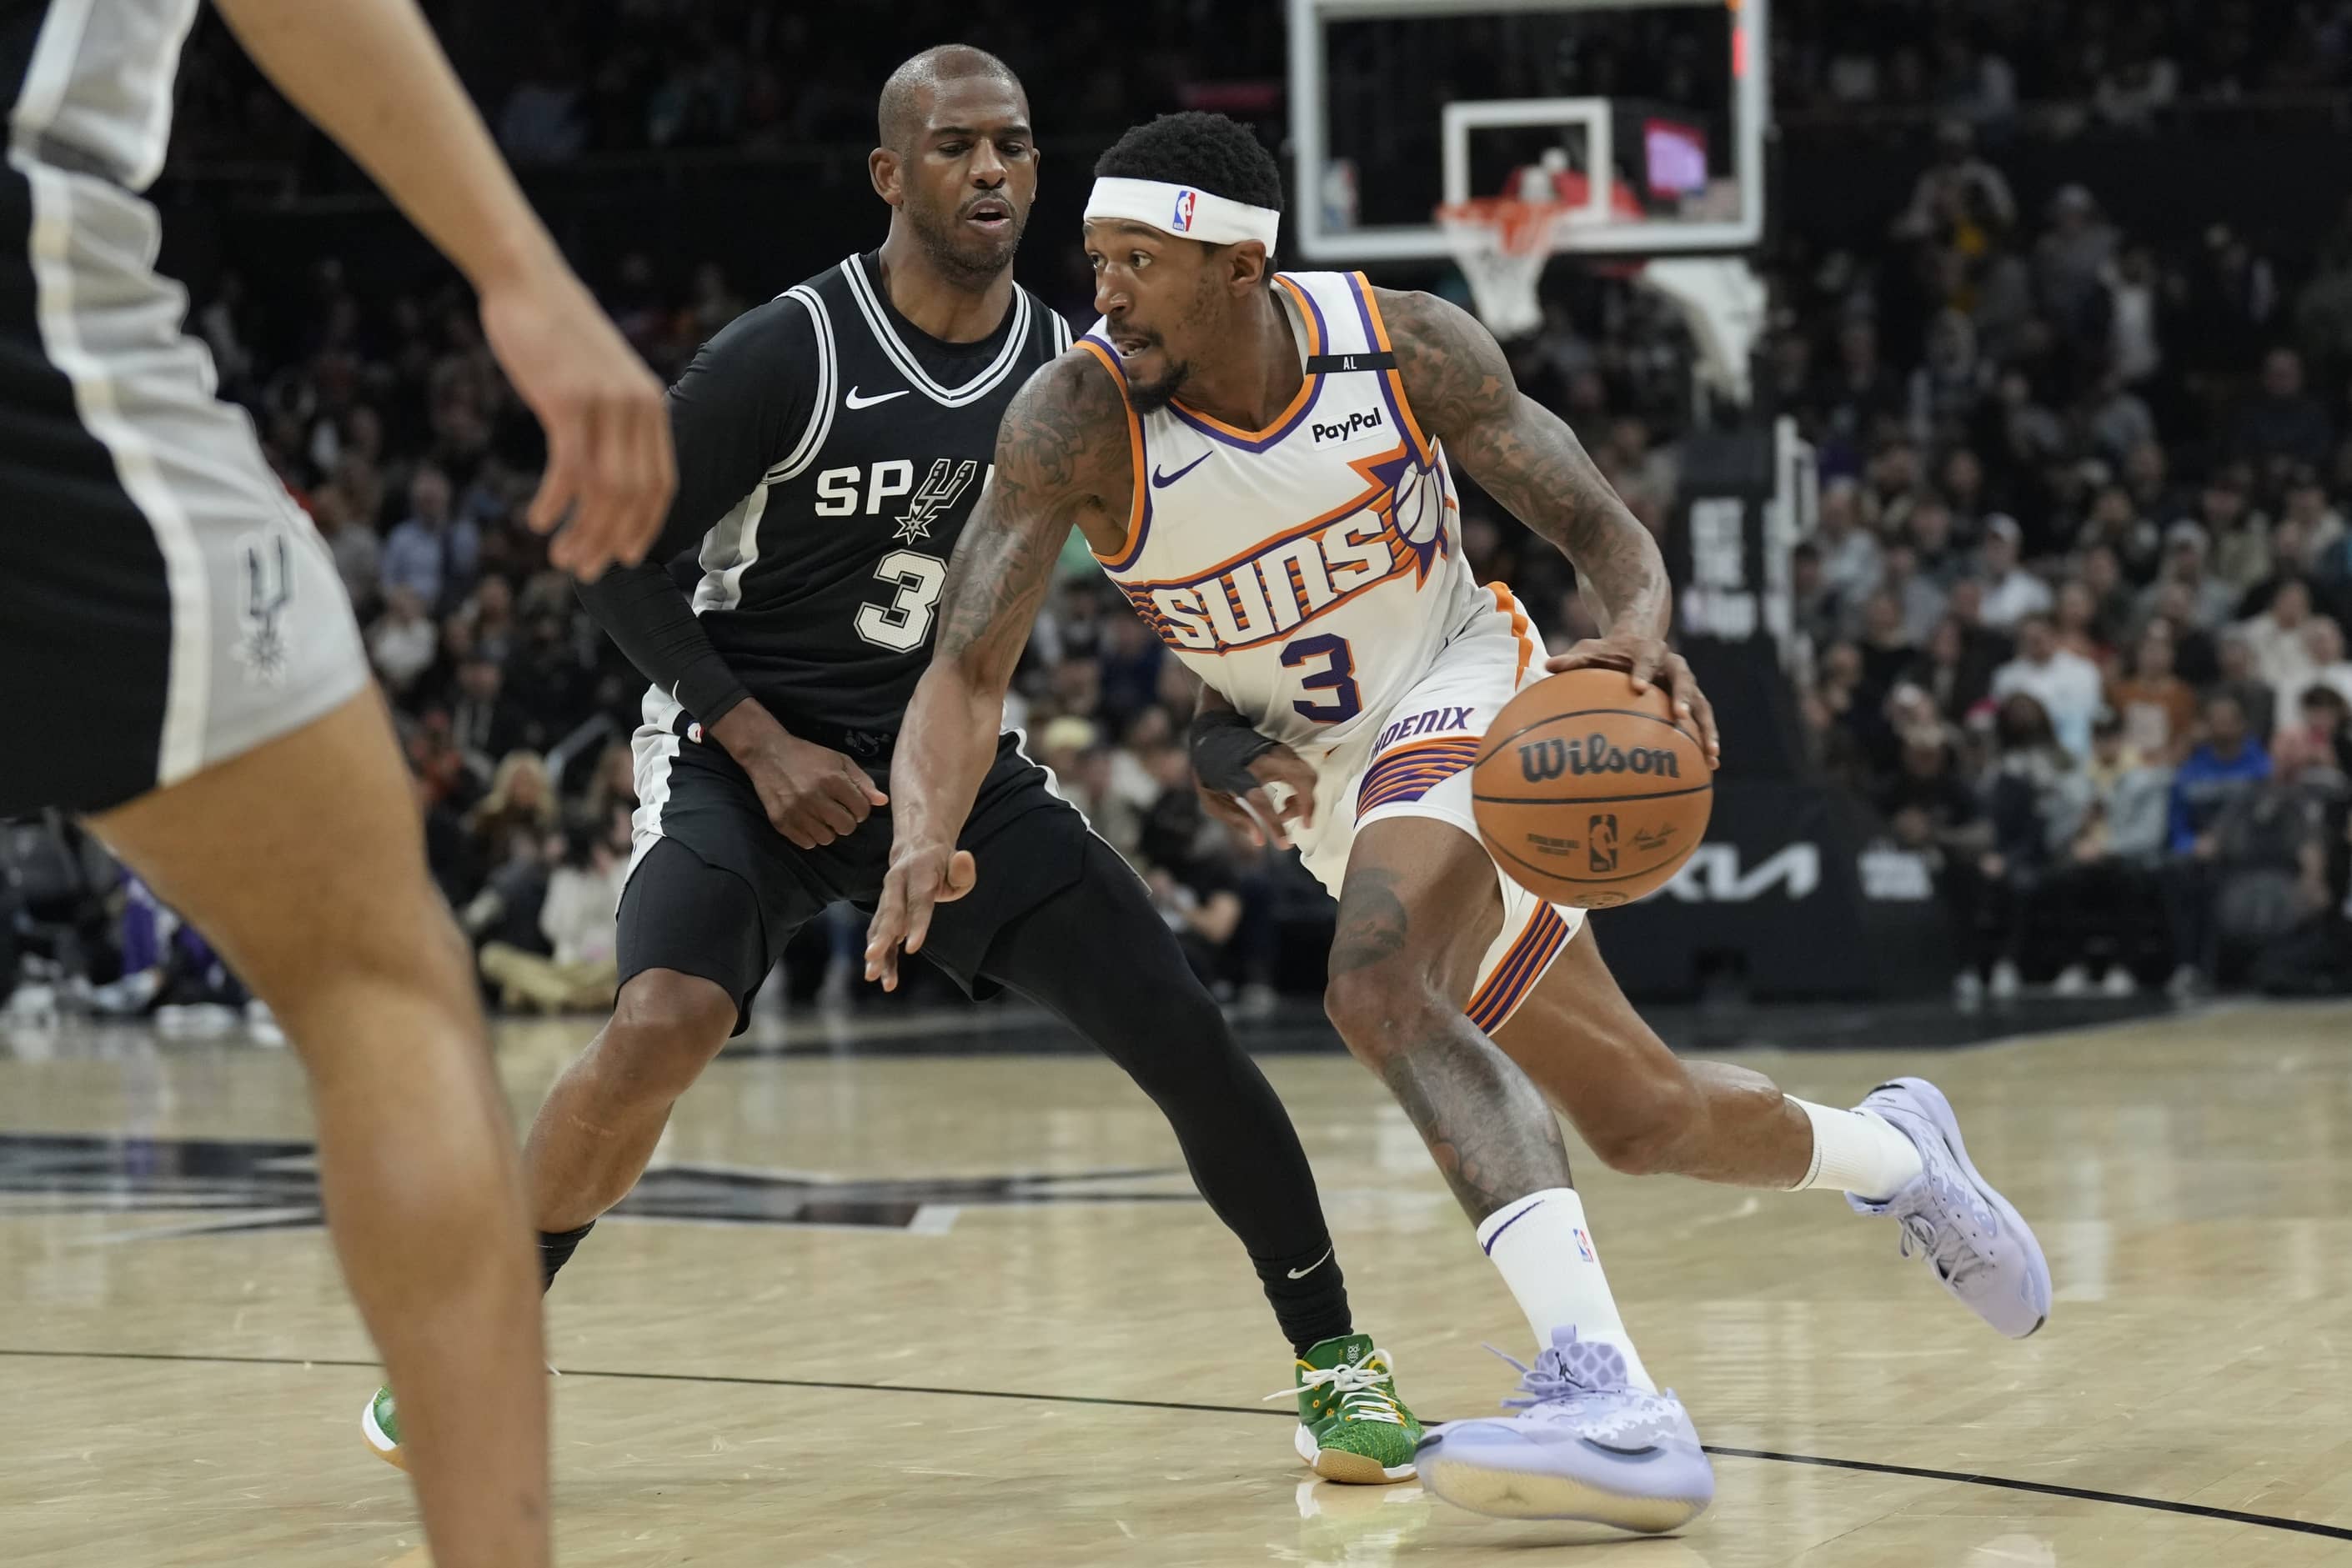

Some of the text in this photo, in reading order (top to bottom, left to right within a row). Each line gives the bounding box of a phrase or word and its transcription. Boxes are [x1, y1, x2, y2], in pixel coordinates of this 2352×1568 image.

[1343, 356, 1357, 370] AL
[1311, 407, 1382, 443] PayPal
[815, 458, 995, 544] SPU
[853, 549, 948, 654] 3
[1151, 509, 1395, 649] SUNS
[1280, 633, 1363, 724] 3
[1372, 707, 1475, 758] HOENIX
[1518, 733, 1680, 783] Wilson
